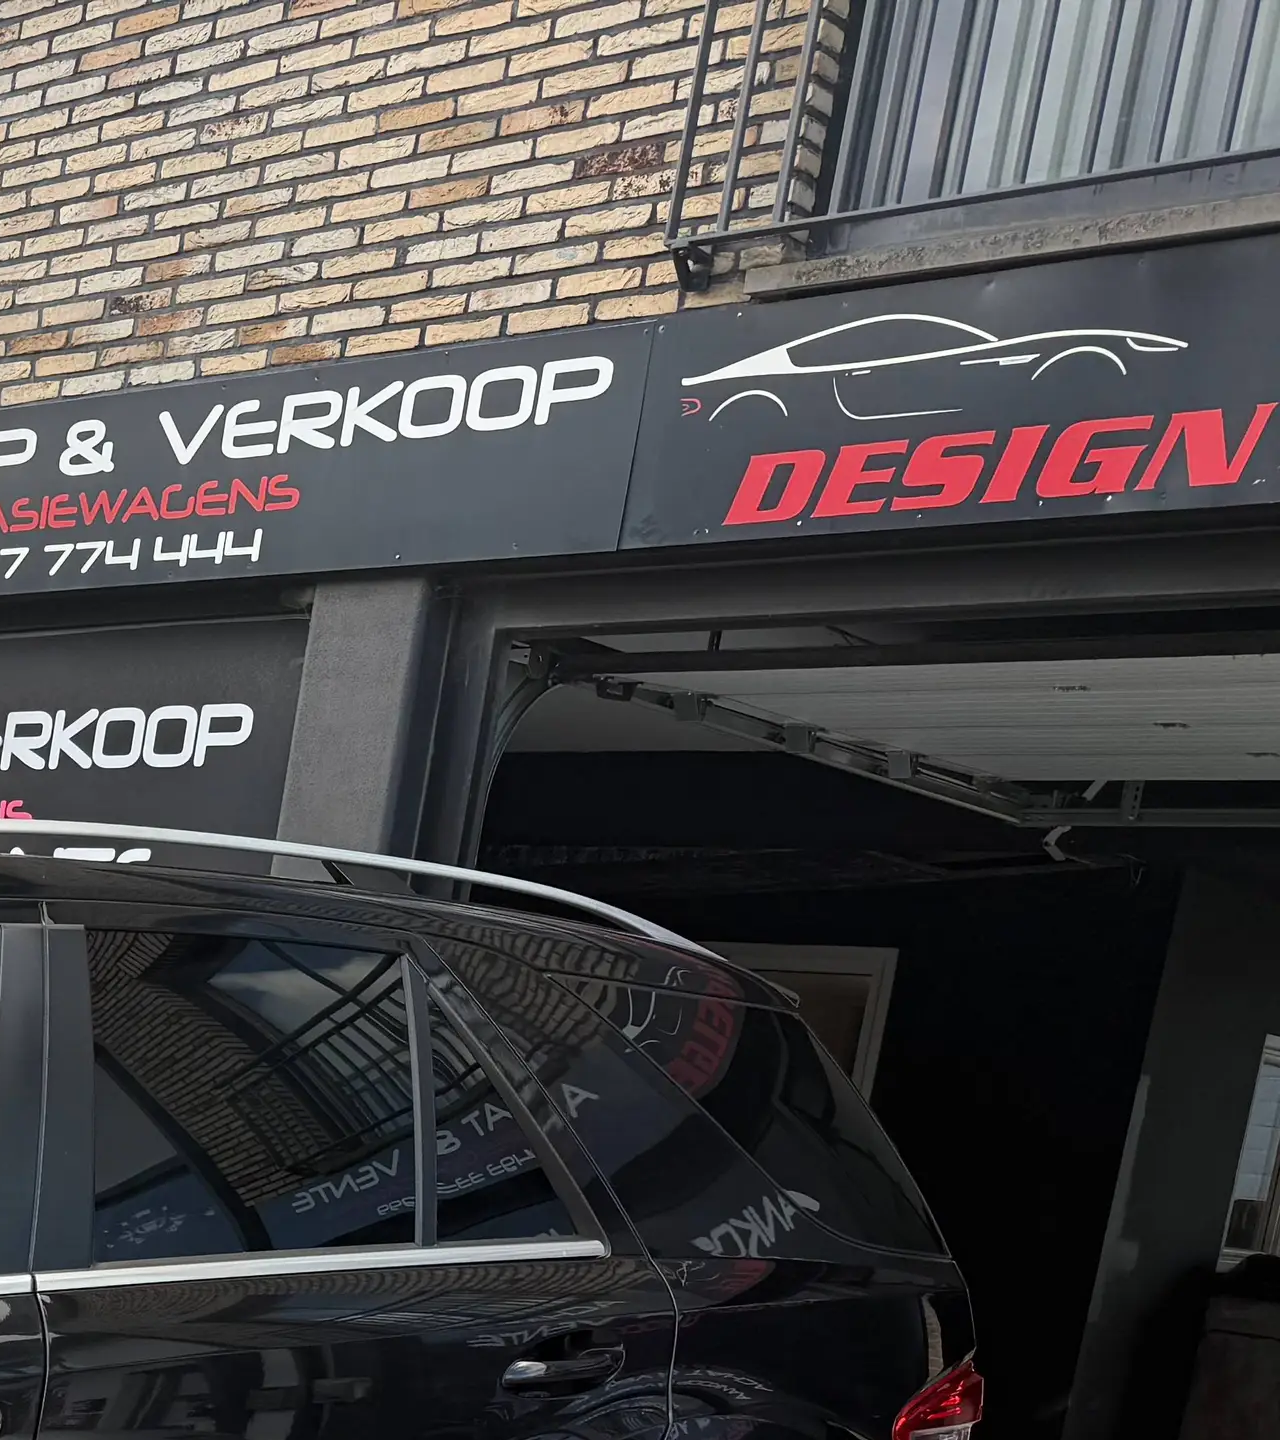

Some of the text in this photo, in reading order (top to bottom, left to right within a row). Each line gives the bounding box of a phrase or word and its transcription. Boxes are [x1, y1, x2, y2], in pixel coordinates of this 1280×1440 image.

[59, 419, 114, 476] &
[159, 355, 614, 465] VERKOOP
[722, 402, 1278, 526] DESIGN
[44, 538, 140, 574] 774
[153, 528, 263, 567] 444
